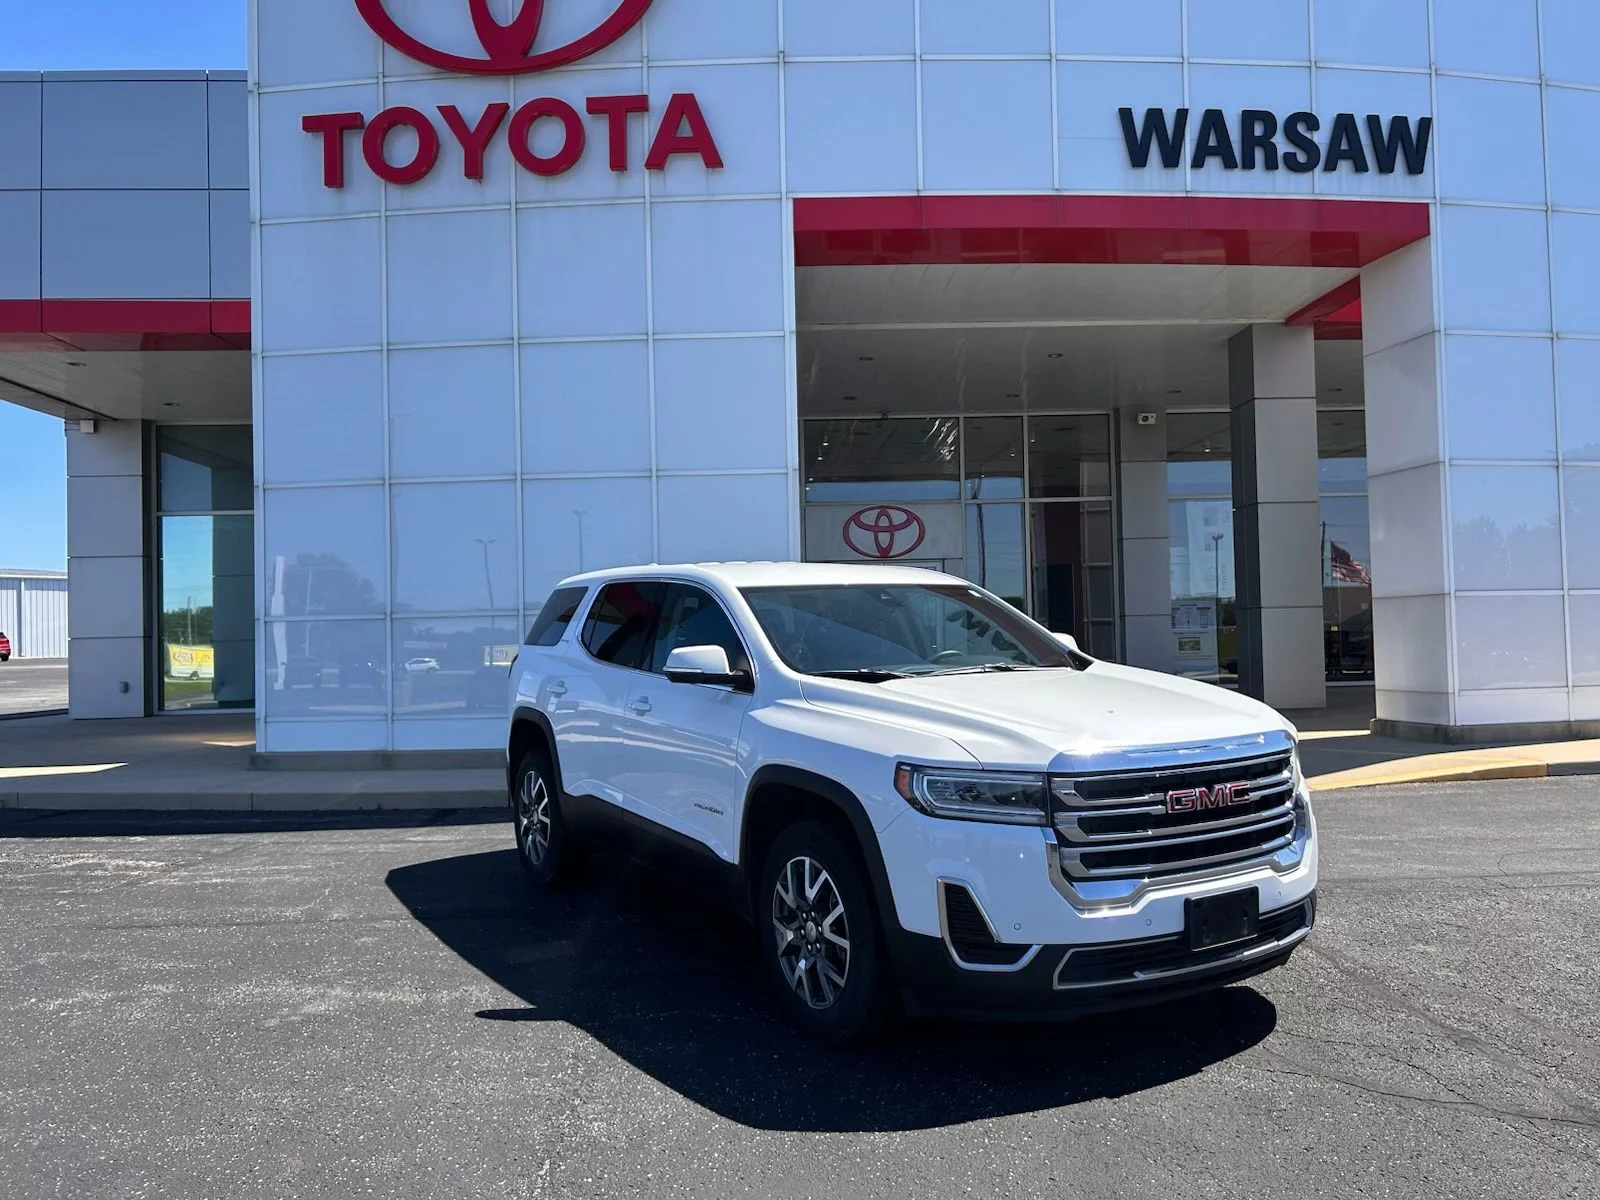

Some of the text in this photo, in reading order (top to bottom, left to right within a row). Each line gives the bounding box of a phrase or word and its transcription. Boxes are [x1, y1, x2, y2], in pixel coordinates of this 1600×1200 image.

[302, 93, 724, 189] TOYOTA
[1118, 107, 1433, 174] WARSAW
[1167, 780, 1250, 813] GMC
